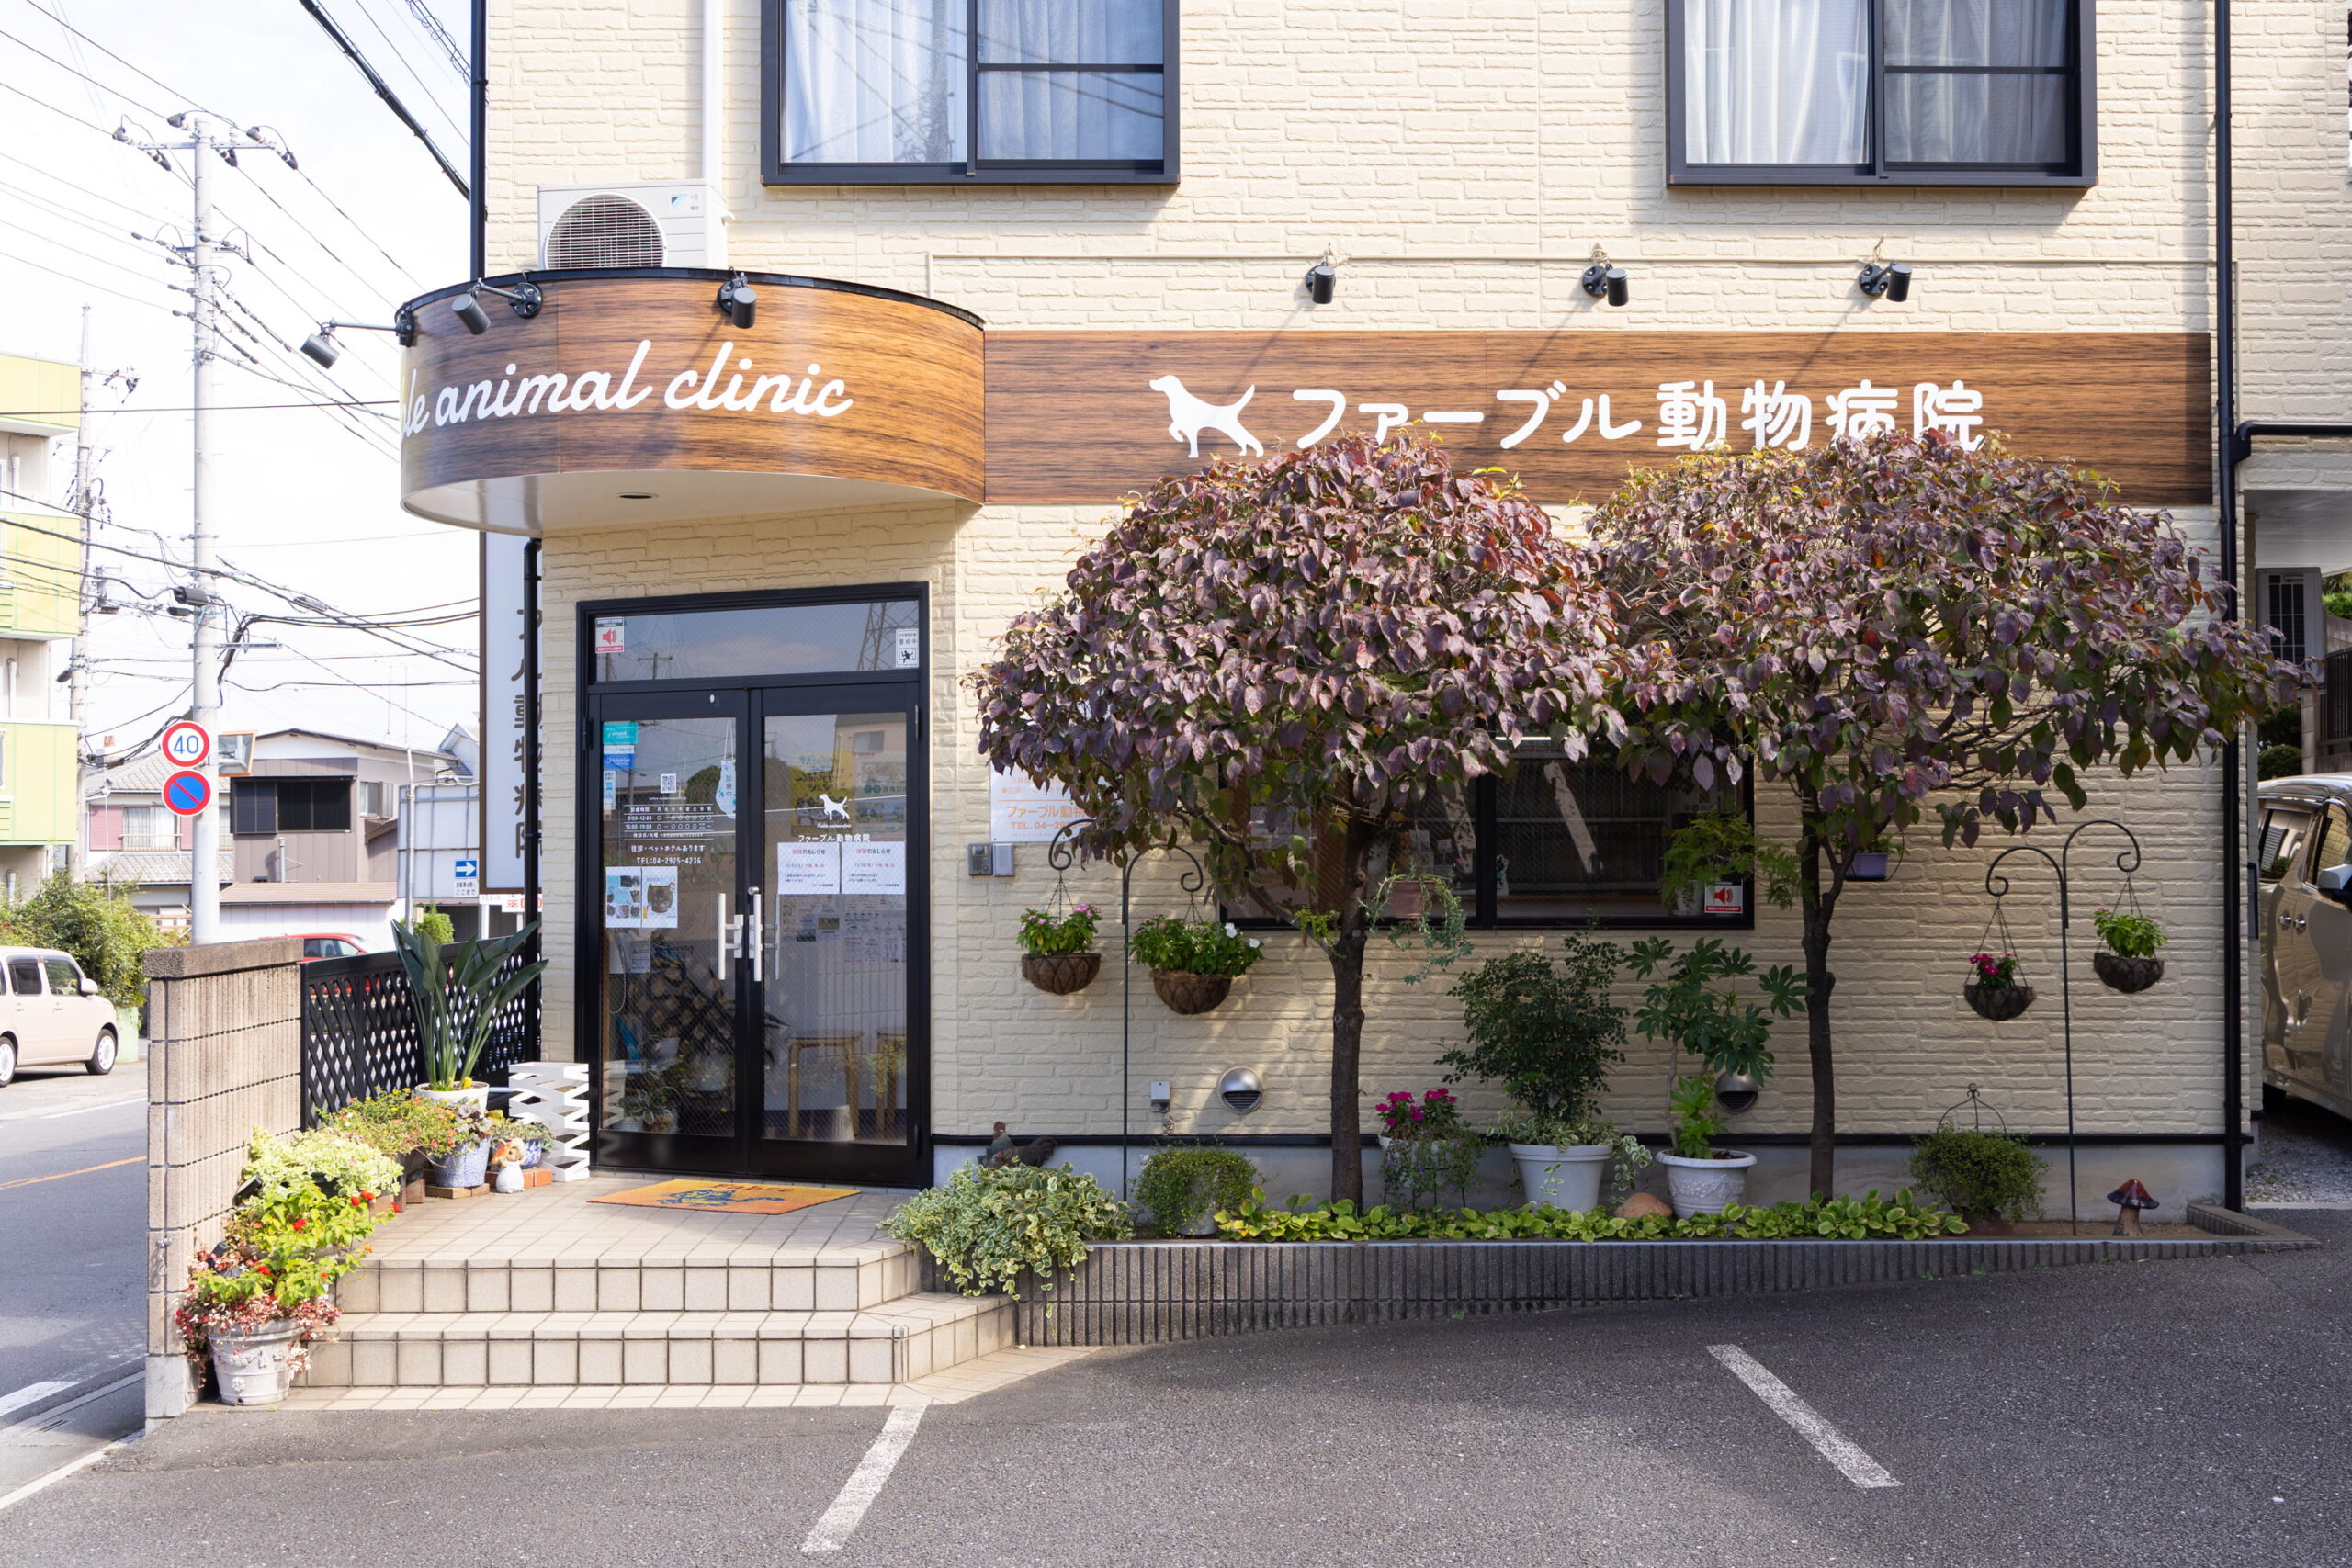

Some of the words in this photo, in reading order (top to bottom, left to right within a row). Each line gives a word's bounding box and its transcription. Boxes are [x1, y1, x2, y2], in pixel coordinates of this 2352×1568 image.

[435, 340, 653, 426] animal
[663, 340, 854, 418] clinic
[1293, 378, 1984, 452] ファーブル動物病院
[174, 735, 199, 754] 40
[798, 833, 870, 842] ファーブル動物病院
